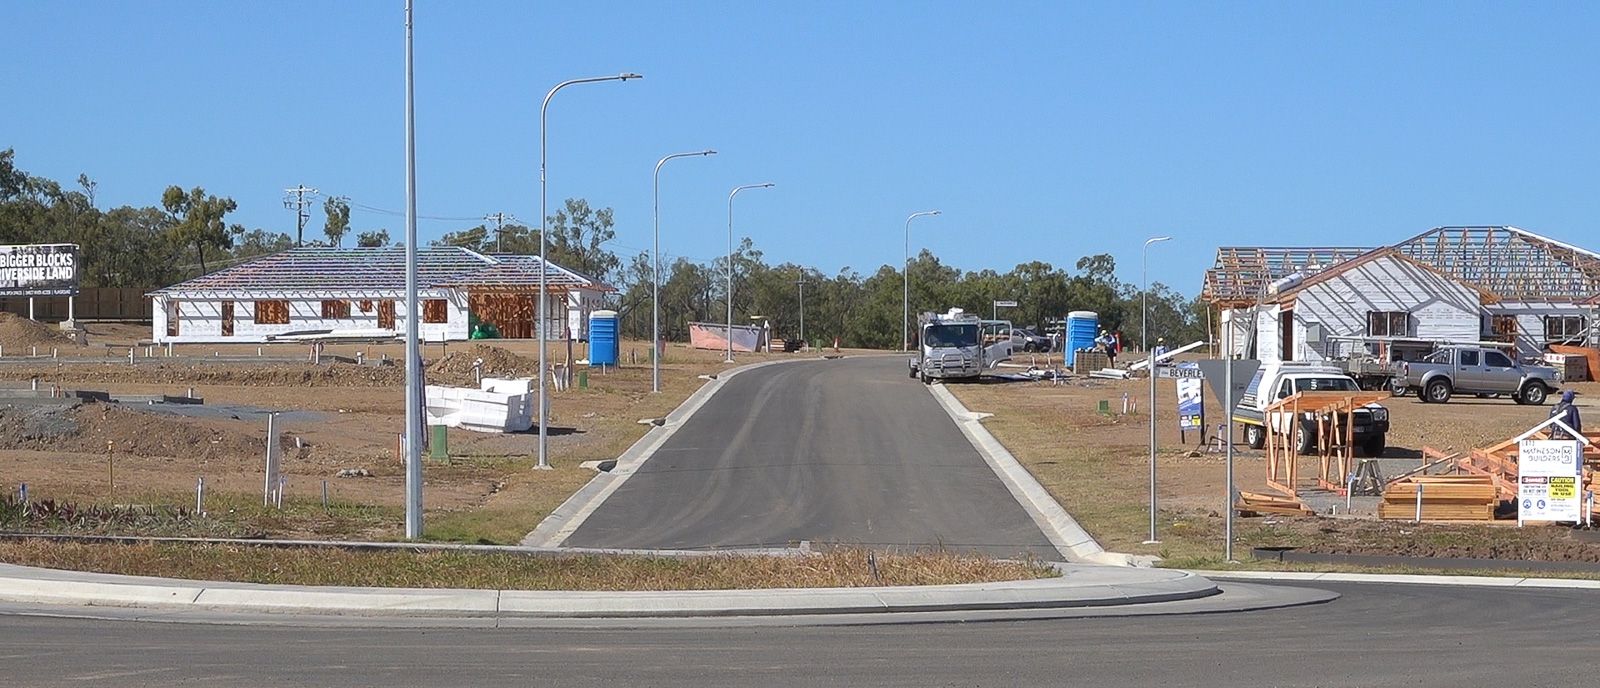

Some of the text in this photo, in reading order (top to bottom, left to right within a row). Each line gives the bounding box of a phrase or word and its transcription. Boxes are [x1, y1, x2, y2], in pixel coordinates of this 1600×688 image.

[0, 253, 73, 267] BIGGER BLOCKS
[0, 266, 73, 281] IVERSIDE LAND
